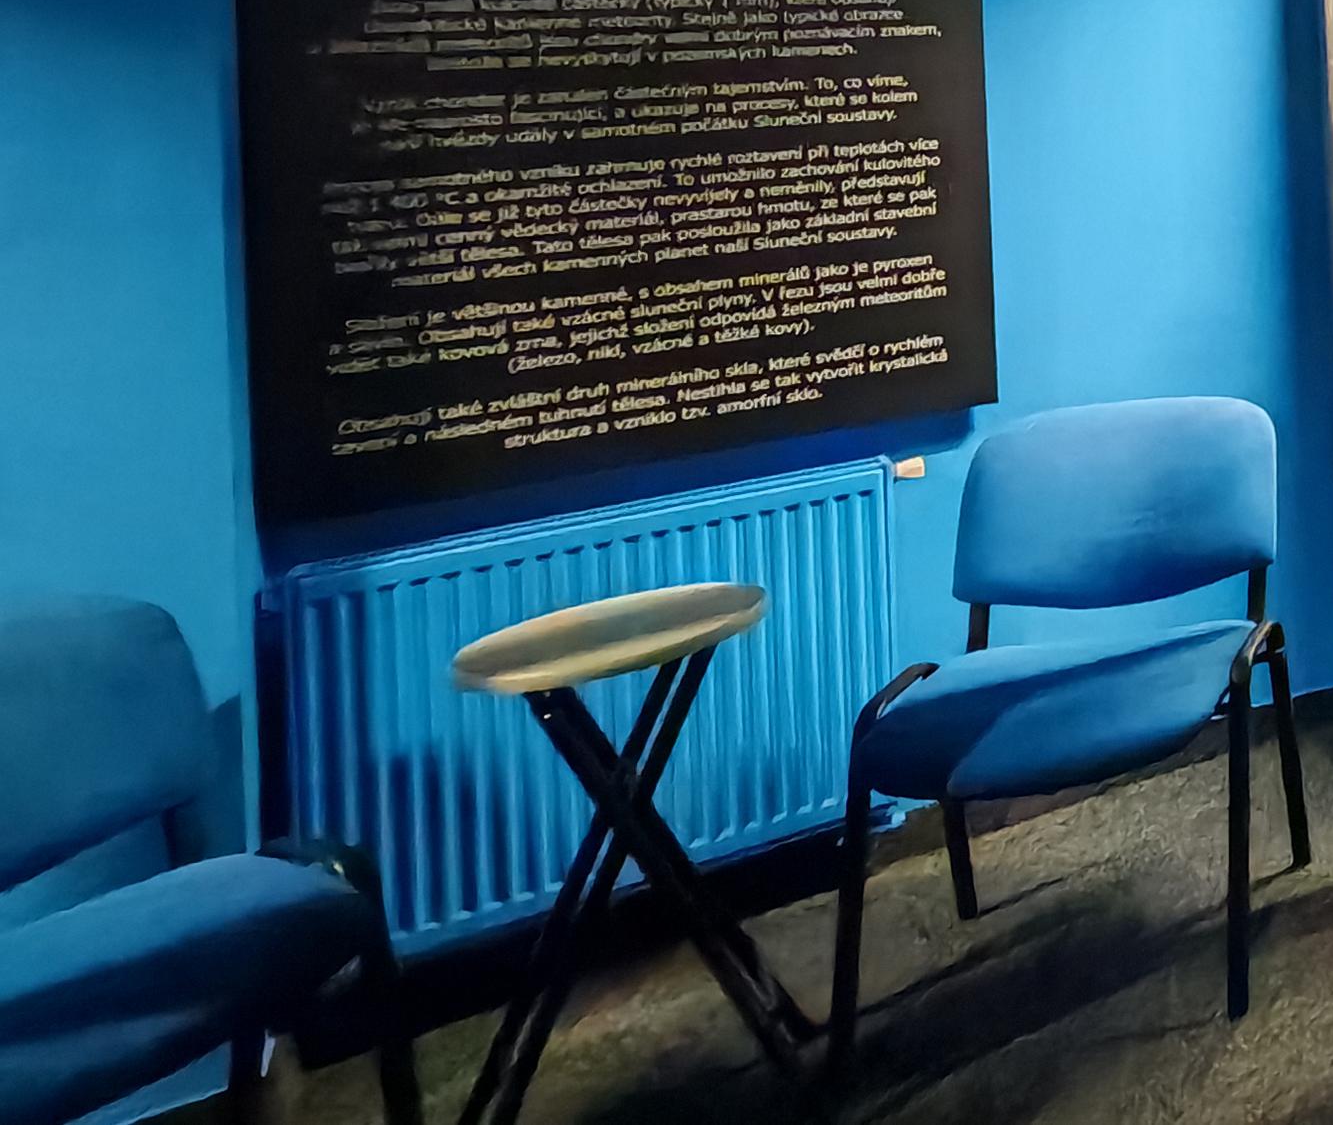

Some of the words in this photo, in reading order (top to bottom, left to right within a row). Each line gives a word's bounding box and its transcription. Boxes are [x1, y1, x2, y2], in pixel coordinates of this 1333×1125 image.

[743, 9, 777, 25] jako
[880, 24, 942, 38] znakem,
[814, 77, 838, 91] To,
[843, 78, 862, 89] co
[705, 101, 727, 114] na
[804, 91, 845, 107] které
[850, 94, 868, 106] se
[872, 89, 917, 104] kolem
[826, 108, 898, 124] soustavy.
[834, 139, 904, 160] teplotách
[908, 137, 939, 151] více
[675, 174, 694, 187] To
[781, 159, 859, 177] zachování
[863, 154, 941, 172] kulovitého
[841, 170, 926, 192] představují
[843, 191, 882, 207] které
[886, 192, 905, 203] se
[909, 187, 937, 203] pak
[640, 229, 671, 247] pak
[766, 217, 801, 235] jako
[805, 211, 870, 228] základní
[873, 201, 937, 221] stavební
[753, 233, 823, 250] Sluneční
[826, 226, 898, 243] soustavy.
[639, 288, 649, 300] s
[815, 264, 849, 281] jako
[853, 261, 869, 276] je
[873, 254, 933, 274] pyroxen
[818, 281, 852, 297] jsou
[901, 267, 946, 284] dobře
[700, 307, 775, 328] odpovídá
[782, 297, 855, 318] železným
[698, 334, 709, 346] a
[765, 318, 816, 337] kovy).
[769, 354, 811, 372] které
[868, 346, 878, 357] o
[883, 334, 944, 355] rychlém
[751, 379, 770, 392] se
[775, 374, 801, 388] tak
[805, 363, 864, 384] vytvořit
[869, 350, 948, 375] krystalická
[717, 392, 781, 416] amorfní
